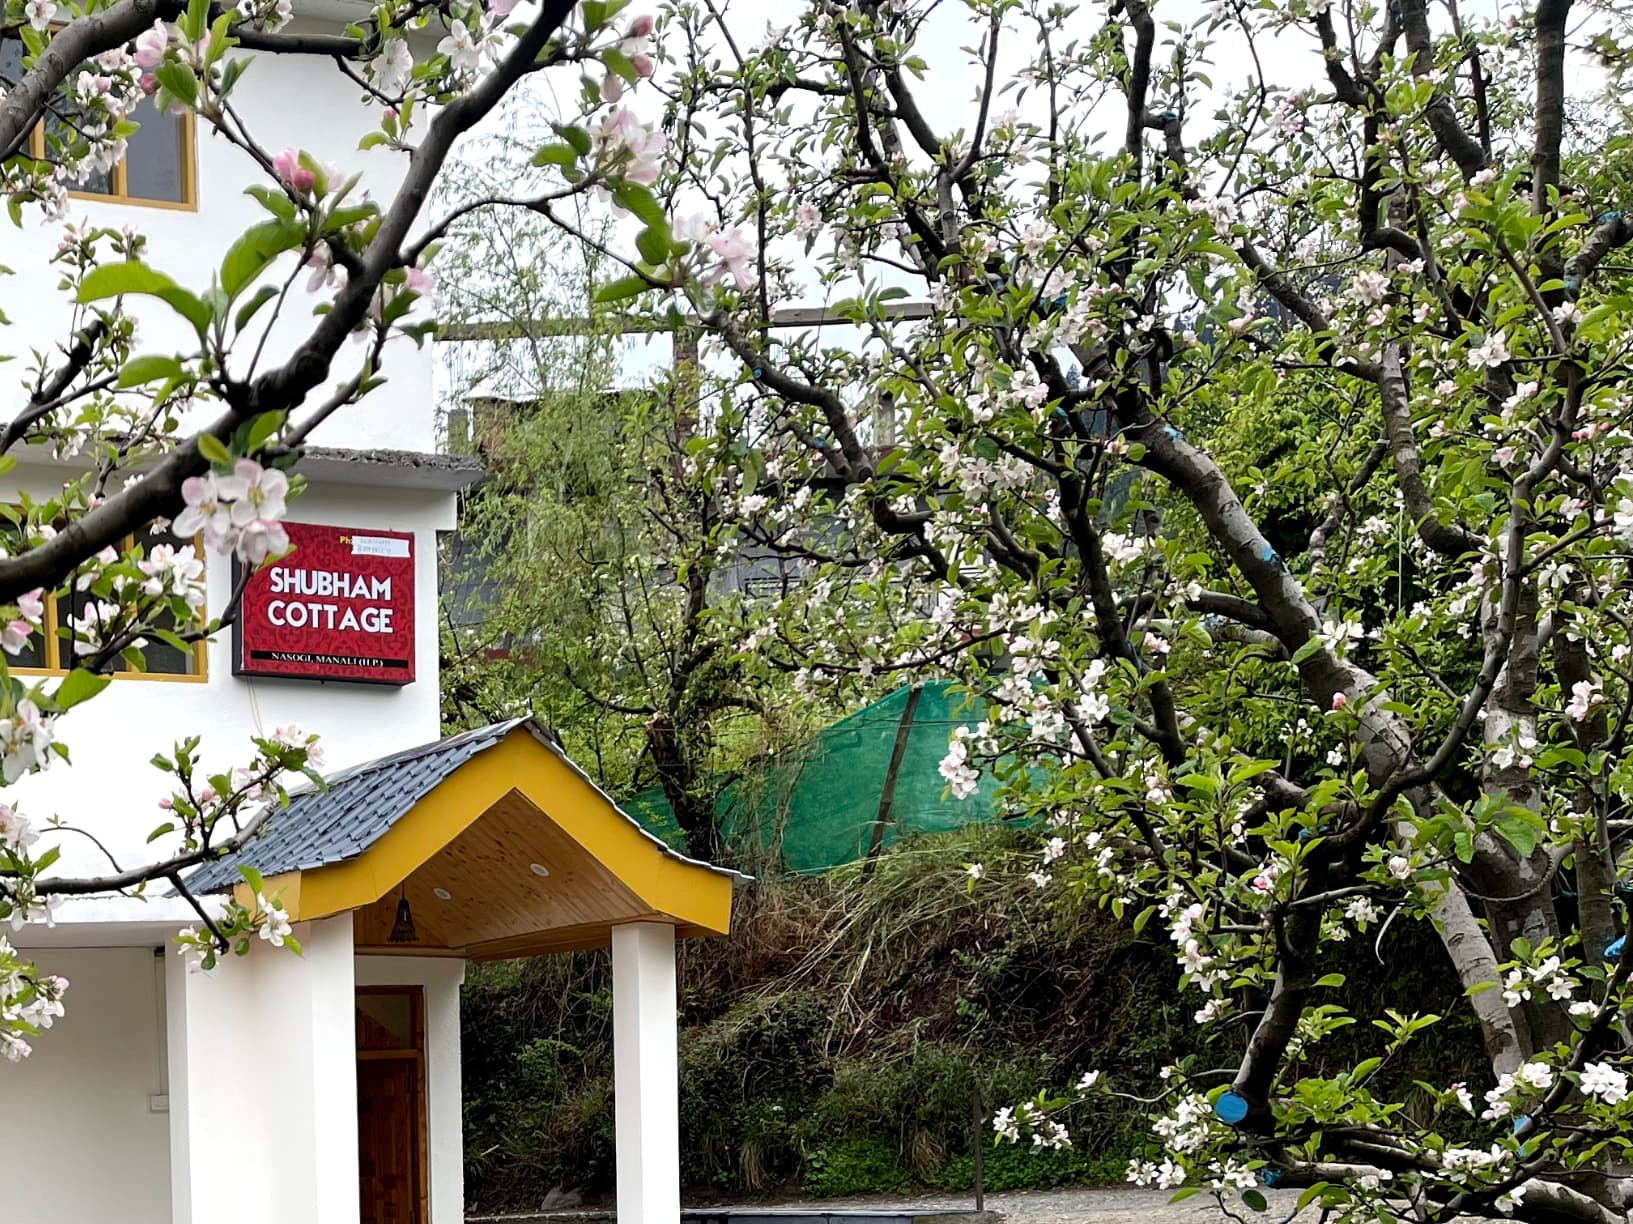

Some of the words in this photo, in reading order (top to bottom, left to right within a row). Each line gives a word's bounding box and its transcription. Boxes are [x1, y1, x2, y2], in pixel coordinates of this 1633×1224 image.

[270, 567, 392, 600] SHUBHAM
[267, 600, 393, 633] COTTAGE
[316, 655, 357, 665] MANALI
